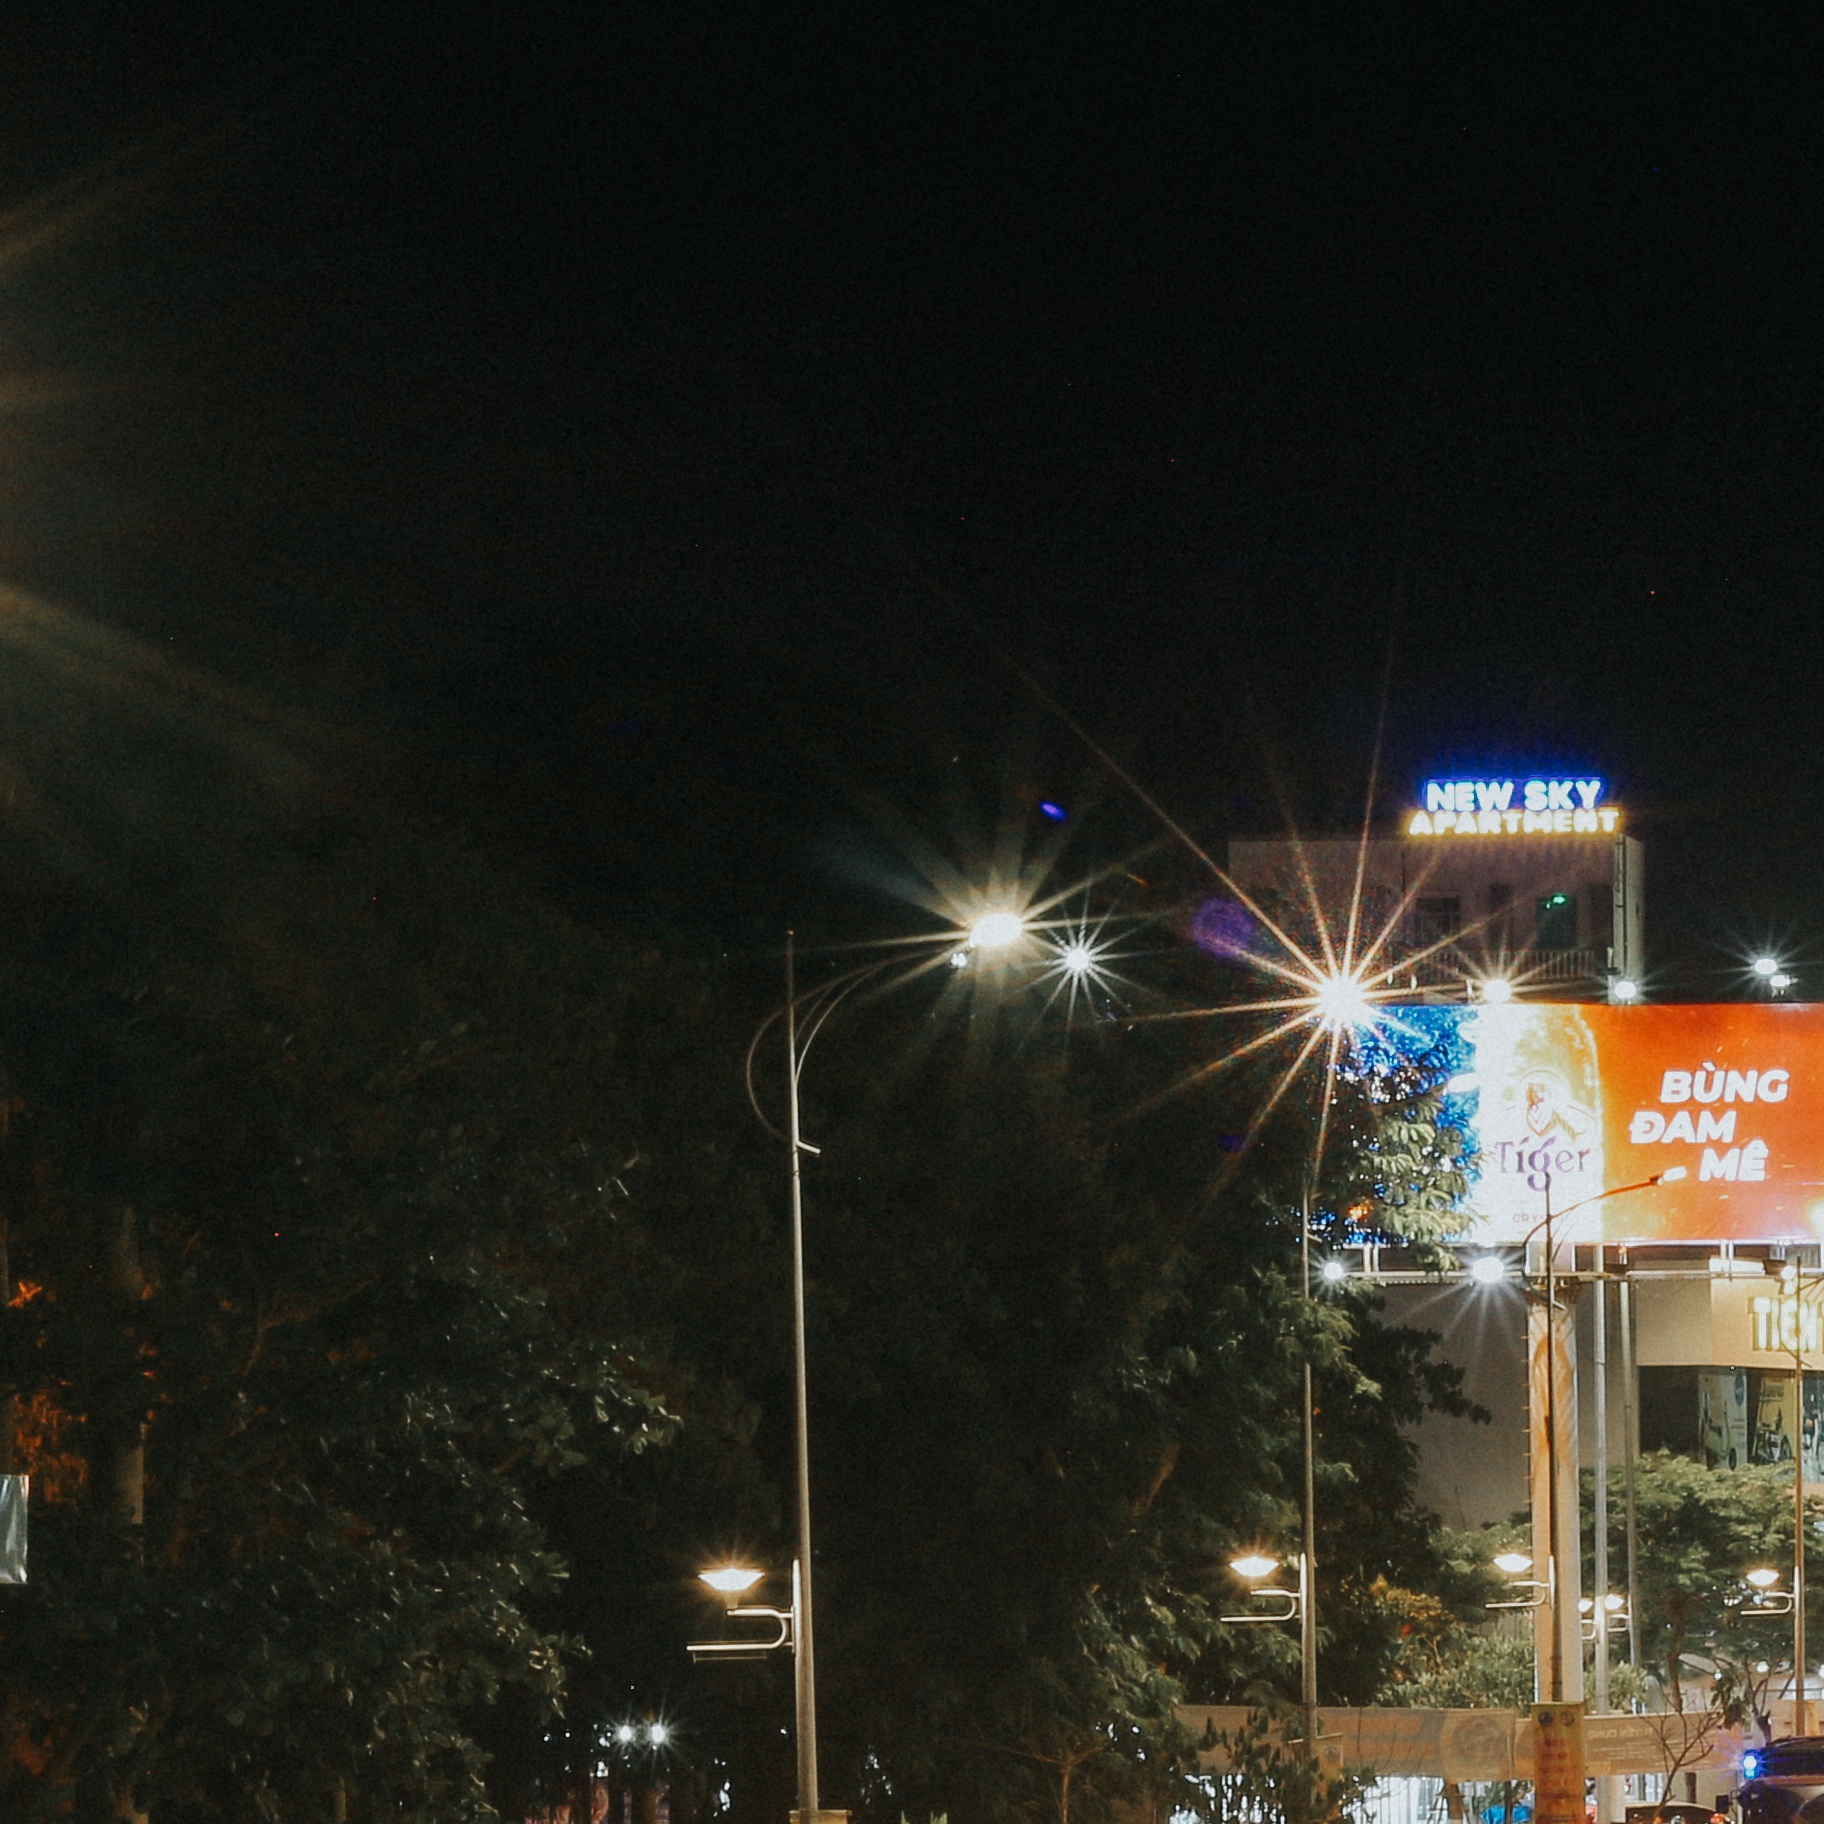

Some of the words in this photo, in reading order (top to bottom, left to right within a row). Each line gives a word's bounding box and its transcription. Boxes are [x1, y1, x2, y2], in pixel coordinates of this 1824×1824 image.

[1427, 781, 1514, 812] NEW
[1524, 780, 1601, 811] SKY
[1409, 810, 1619, 834] APARTMENT
[1660, 1061, 1790, 1103] BÙNG
[1629, 1111, 1737, 1144] ĐAM
[1496, 1136, 1590, 1192] Tiger
[1699, 1138, 1768, 1182] MÊ
